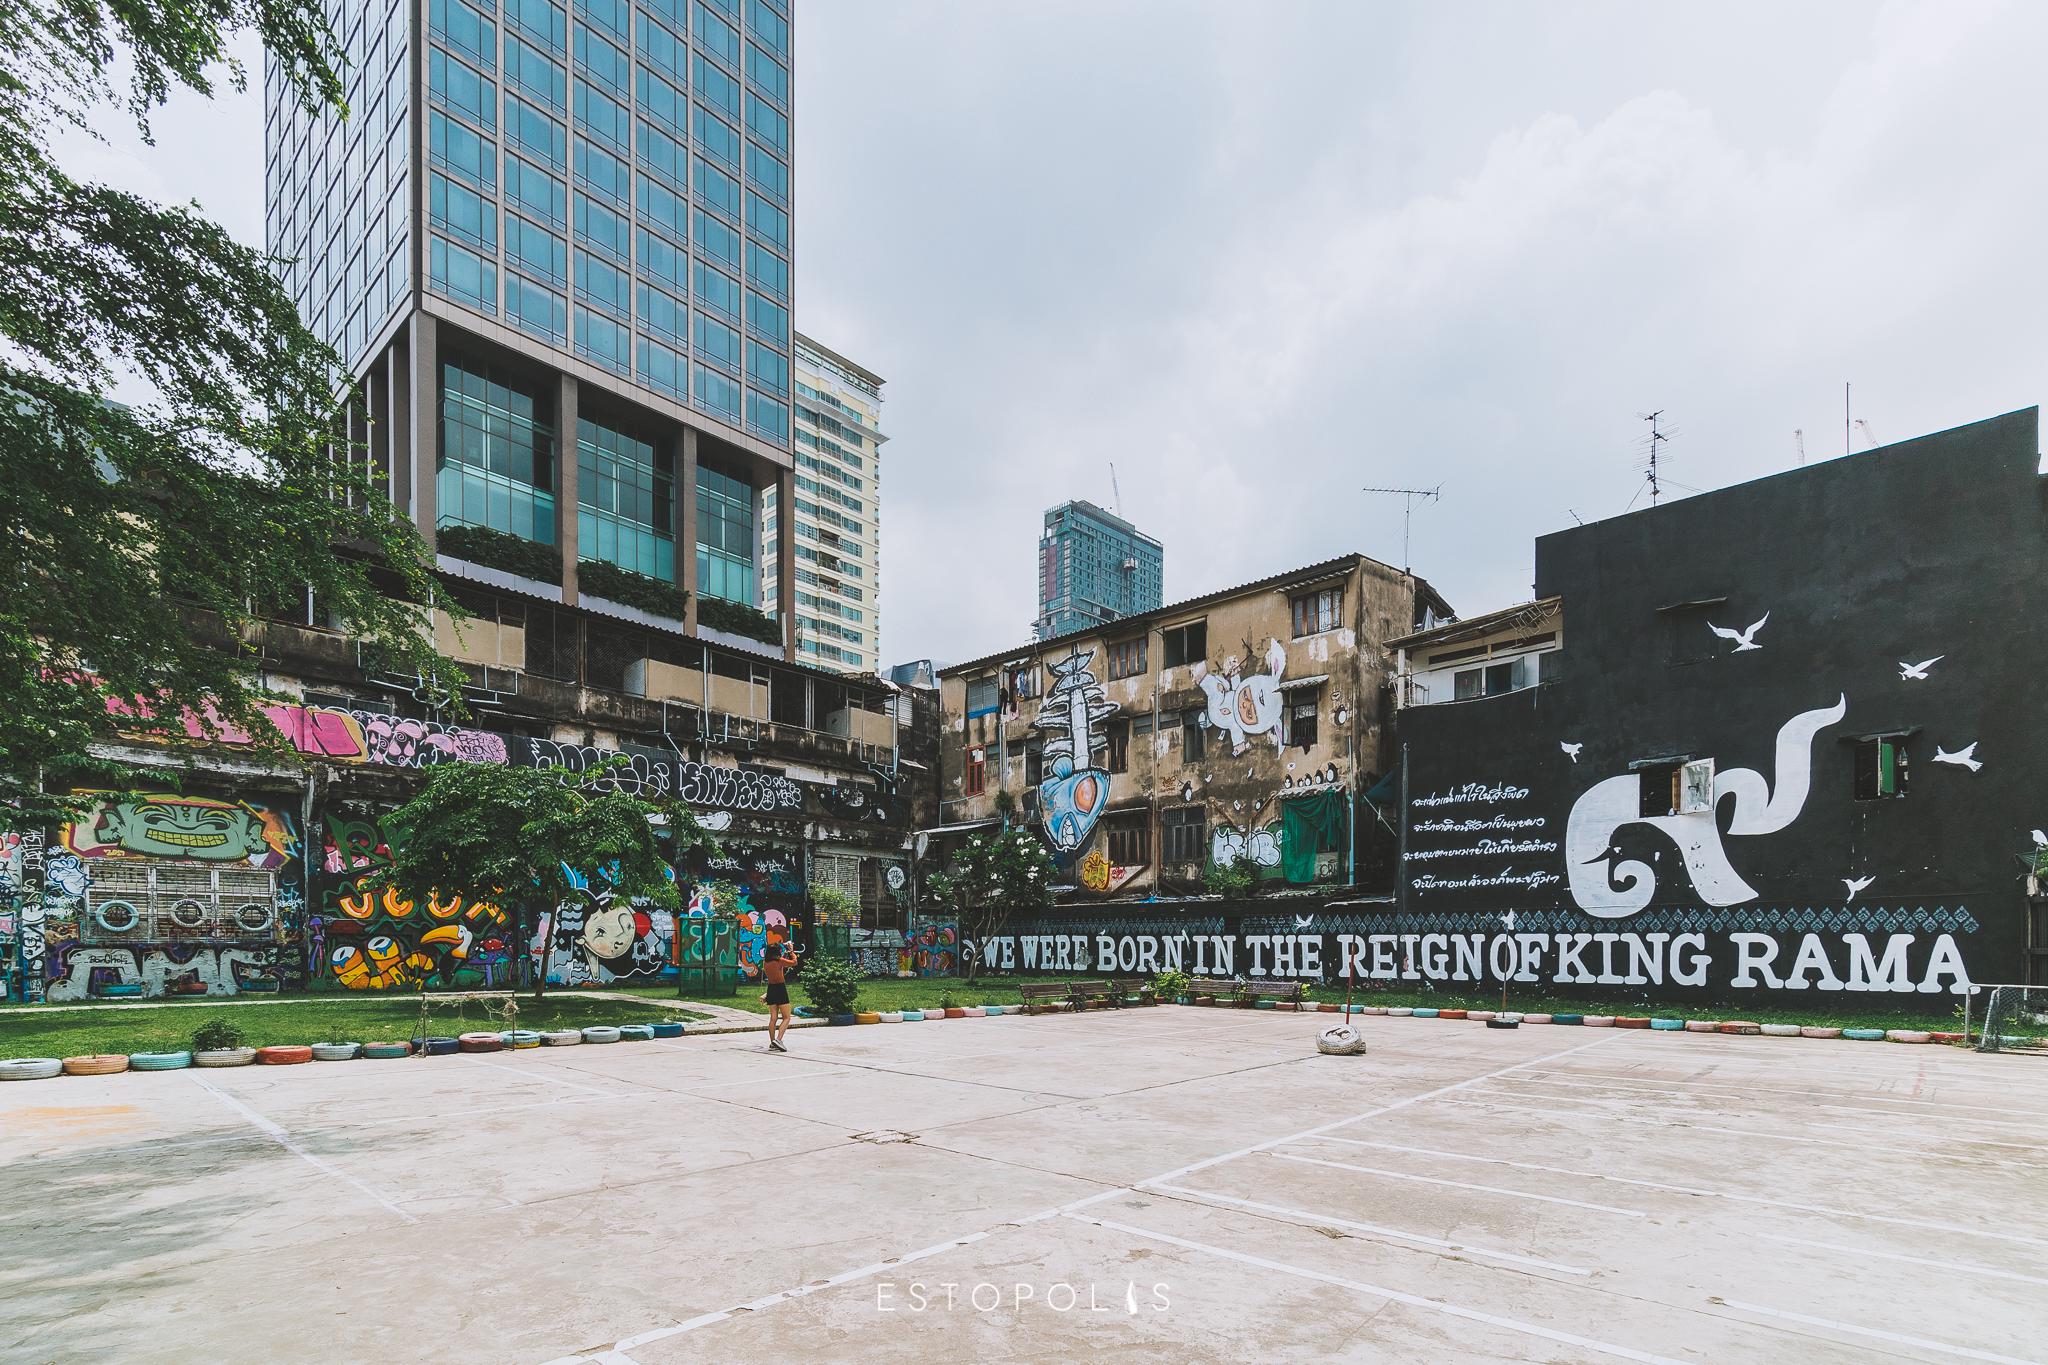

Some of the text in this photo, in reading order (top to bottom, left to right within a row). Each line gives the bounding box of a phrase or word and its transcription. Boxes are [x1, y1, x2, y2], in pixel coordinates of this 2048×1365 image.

[981, 935, 1015, 971] WE
[1020, 934, 1088, 971] WERE
[1096, 934, 1184, 975] BORN
[1193, 934, 1238, 976] IN
[1245, 933, 1323, 978] THE
[1336, 933, 1486, 981] REIGN
[1488, 932, 1550, 983] OF
[1552, 931, 1713, 987] KING
[1728, 932, 1982, 996] RAMA
